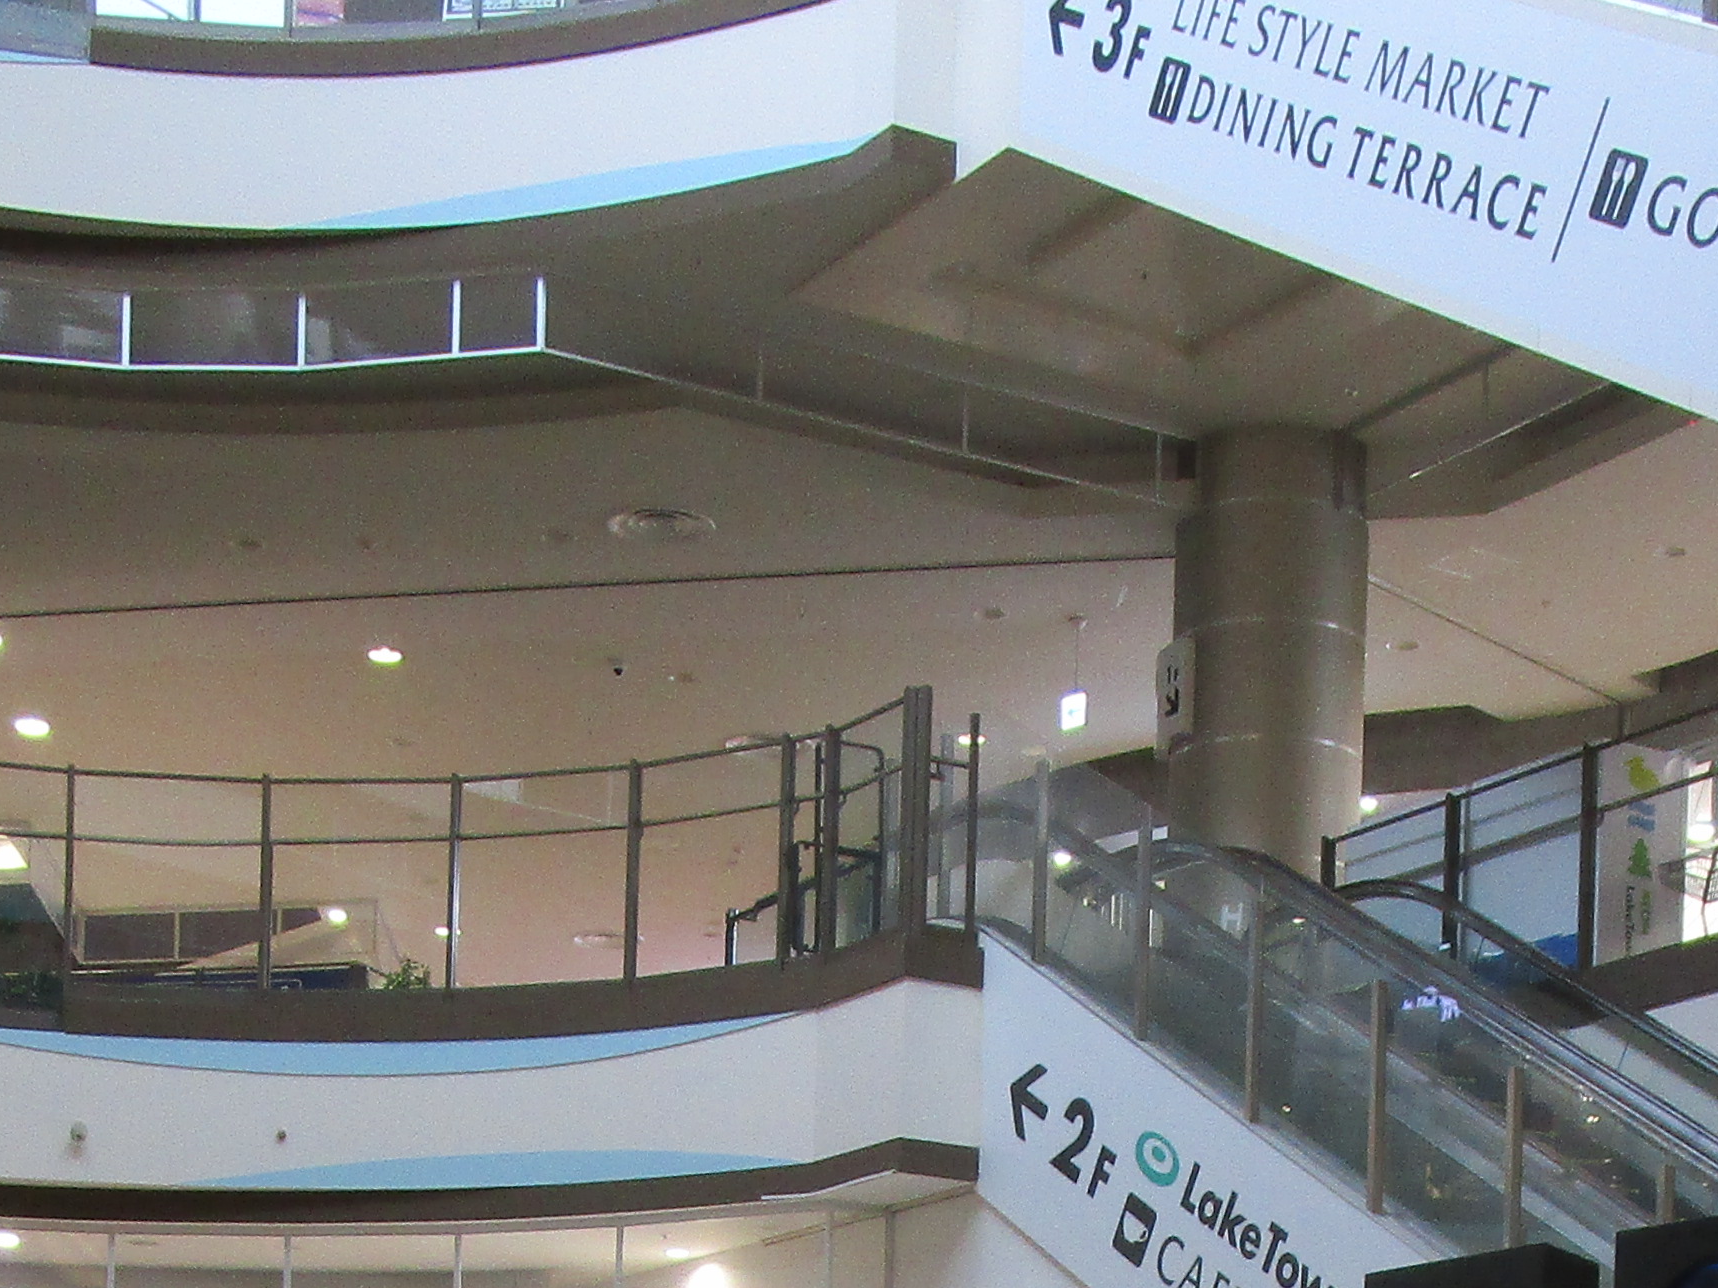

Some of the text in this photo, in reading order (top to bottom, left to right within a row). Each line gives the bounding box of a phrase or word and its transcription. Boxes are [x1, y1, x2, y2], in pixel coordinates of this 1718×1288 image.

[1091, 0, 1152, 80] 3F
[1171, 0, 1551, 139] LIFE STYLE MARKET
[1186, 74, 1549, 240] DINING TERRACE
[1049, 1096, 1118, 1199] 2F
